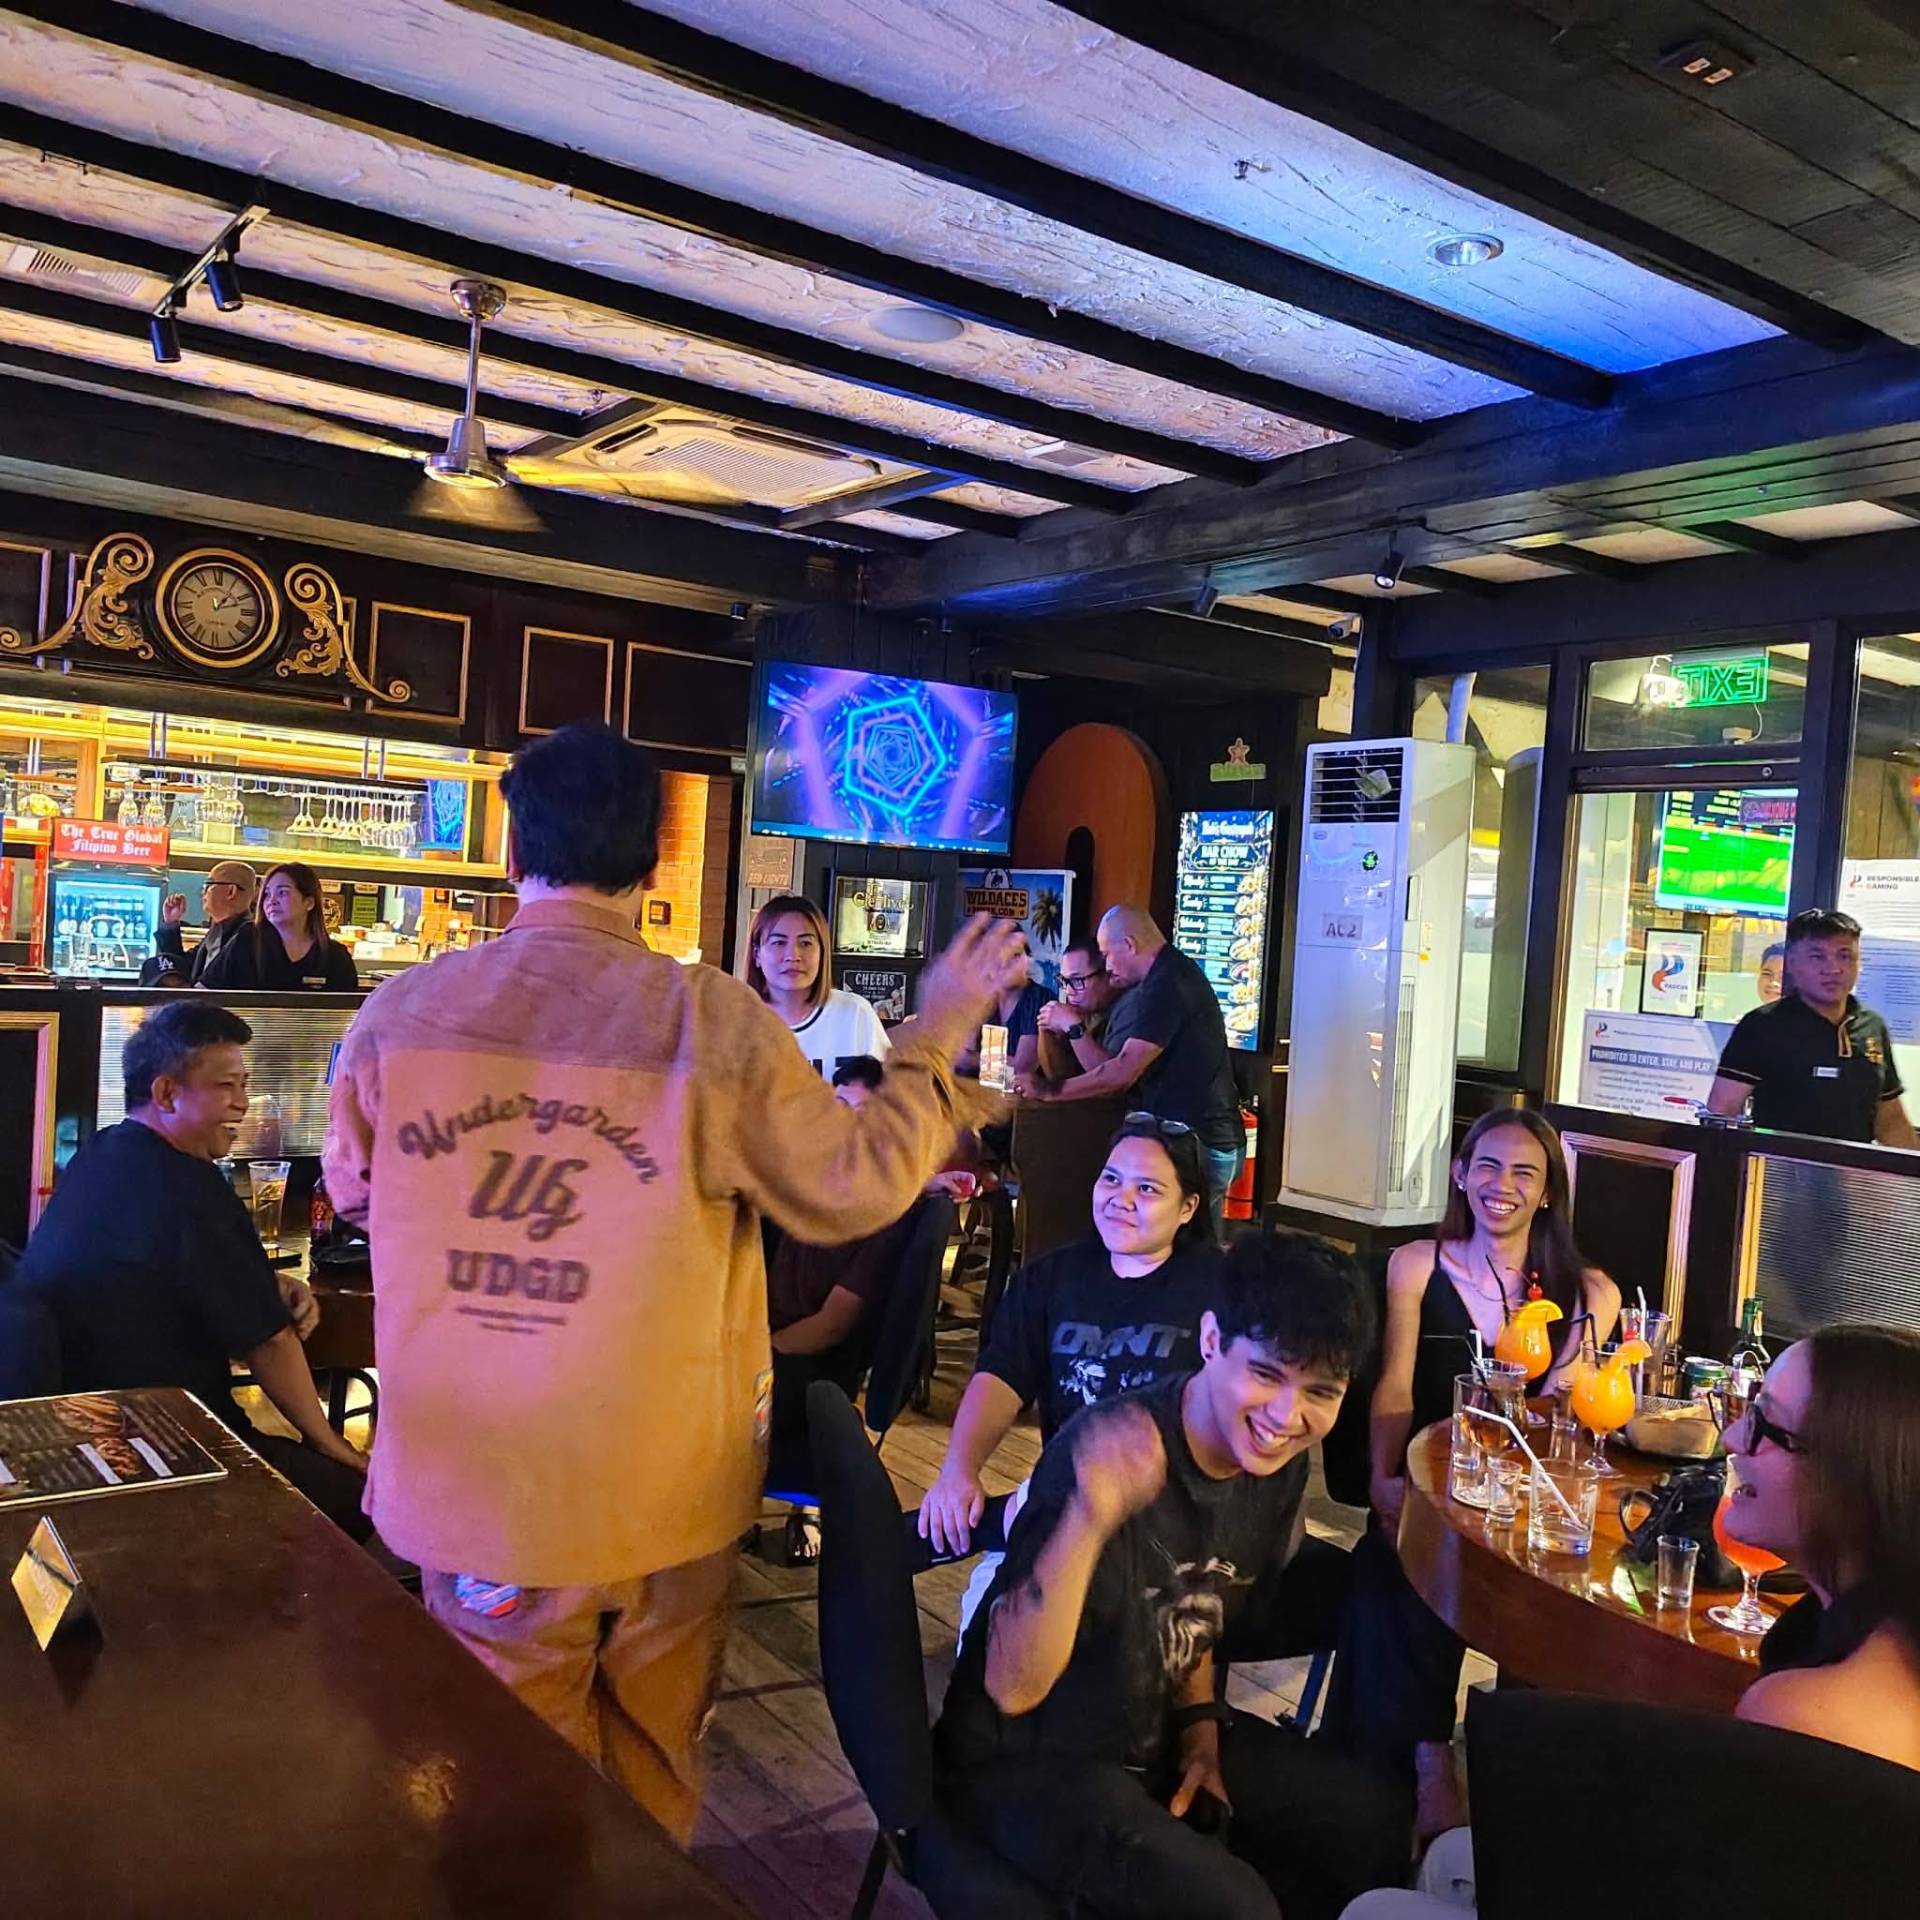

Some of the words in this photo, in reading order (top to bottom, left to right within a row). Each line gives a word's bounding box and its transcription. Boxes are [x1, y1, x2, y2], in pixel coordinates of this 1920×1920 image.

[61, 823, 85, 838] The
[90, 826, 119, 841] True
[124, 829, 163, 844] Global
[70, 839, 117, 855] Filipino
[122, 842, 151, 857] Beer
[1867, 875, 1920, 883] RESPONSIBLE
[966, 889, 1027, 908] WILDACES
[158, 956, 174, 971] LA
[855, 973, 896, 987] CHEERS
[446, 1248, 591, 1304] UDGD
